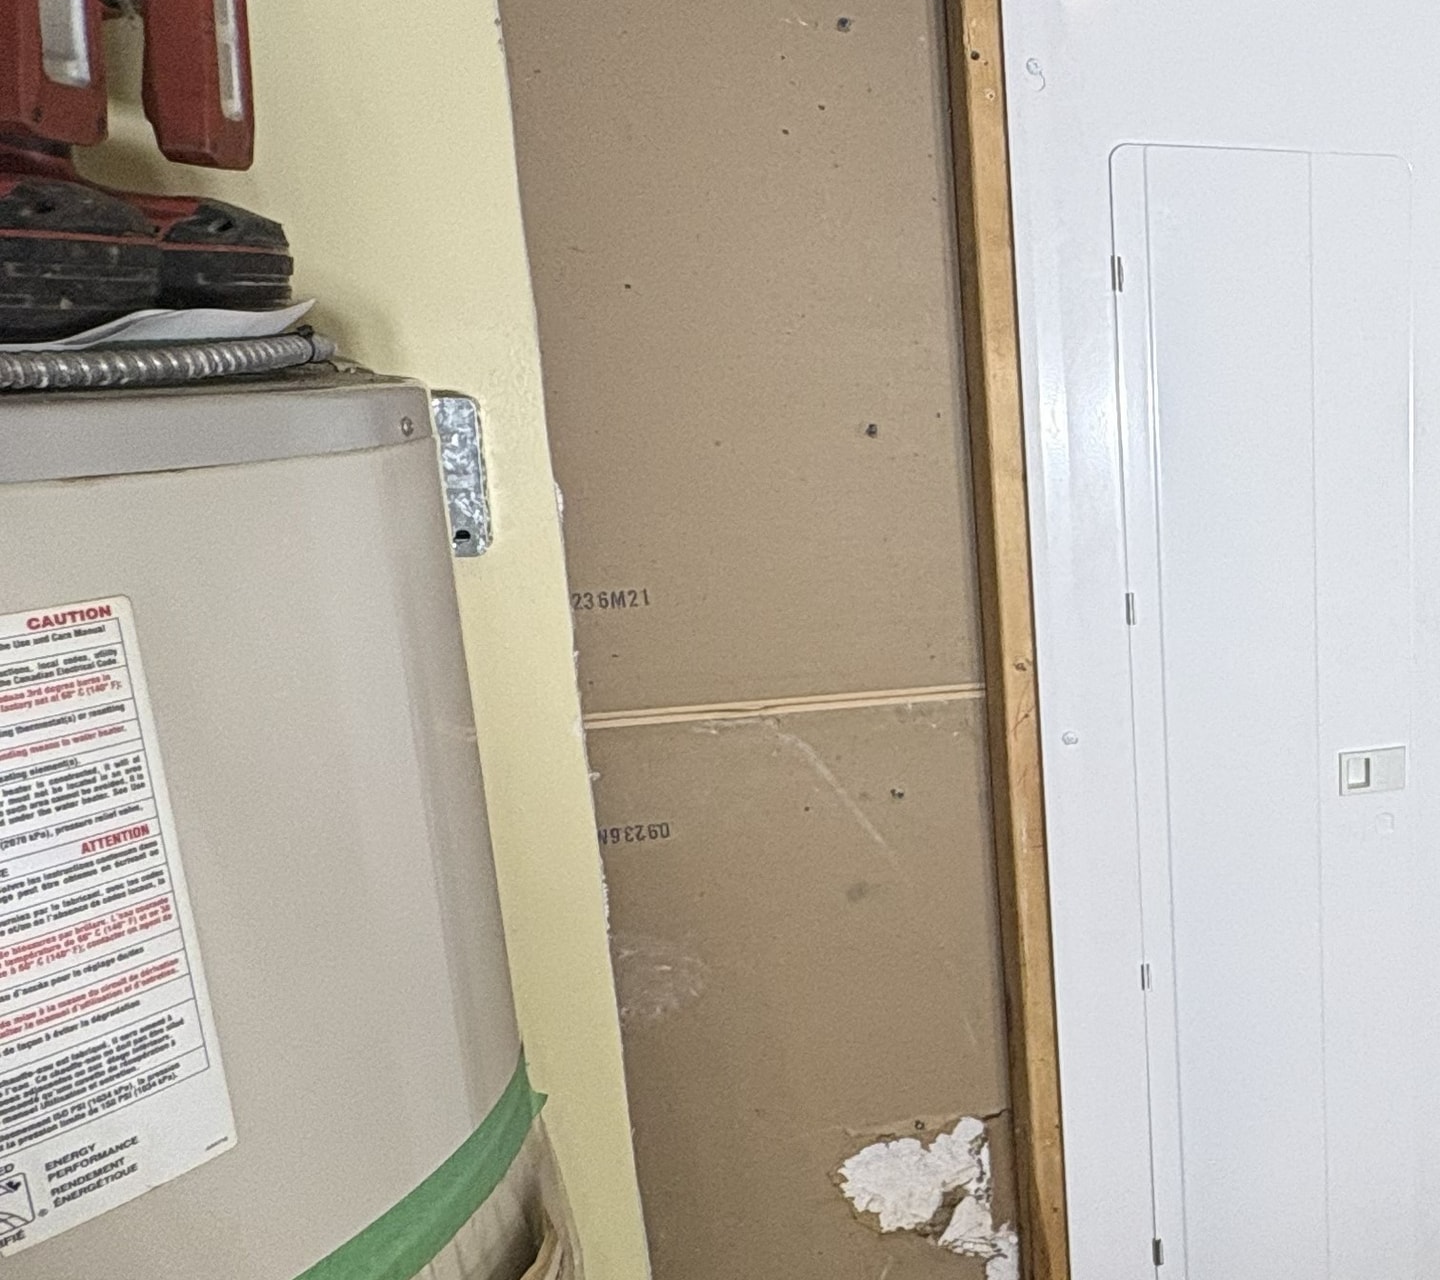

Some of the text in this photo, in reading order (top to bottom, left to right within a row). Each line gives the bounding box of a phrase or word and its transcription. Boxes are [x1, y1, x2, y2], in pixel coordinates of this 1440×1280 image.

[571, 587, 650, 611] 236M21
[26, 605, 111, 630] CAUTION
[81, 824, 150, 854] ATTENTION
[45, 1143, 96, 1172] ENERGY
[47, 1136, 139, 1182] PERFORMANCE
[51, 1157, 126, 1197] RENDEMENT
[53, 1163, 139, 1208] ÉNERGÉTIQUE
